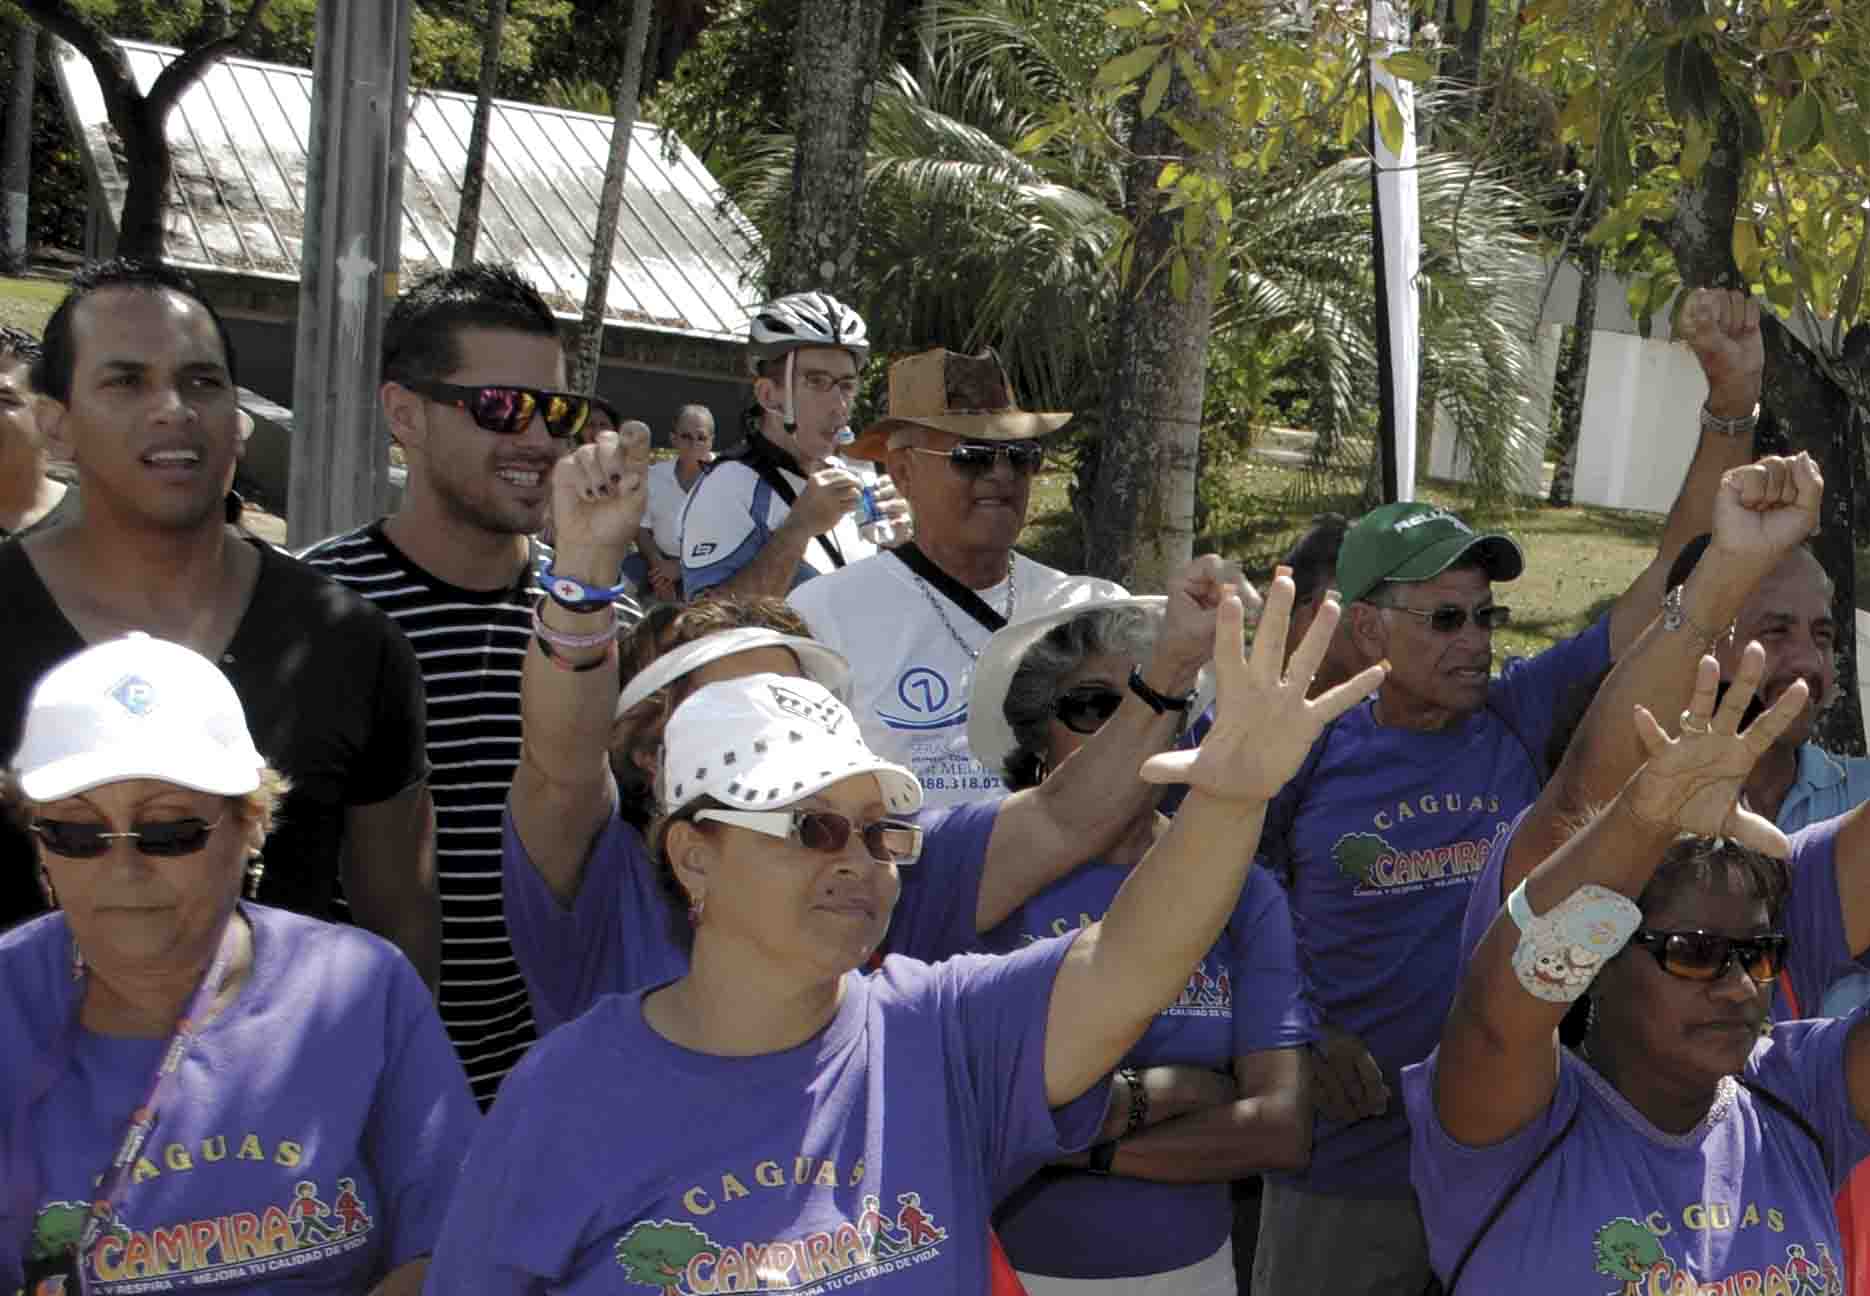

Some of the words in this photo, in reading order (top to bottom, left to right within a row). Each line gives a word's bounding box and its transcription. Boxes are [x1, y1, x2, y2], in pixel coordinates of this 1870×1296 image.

[1374, 794, 1500, 830] CAGUAS
[1376, 838, 1492, 887] CAMPIRA
[96, 1134, 304, 1187] AGUAS
[95, 1205, 299, 1282] CAMPIRA
[1646, 1201, 1785, 1236] CGUAS
[116, 1278, 174, 1296] RESPIRA
[192, 1267, 247, 1286] MEJORA
[249, 1263, 267, 1276] TU
[267, 1250, 323, 1271] CALIDAD
[325, 1245, 343, 1259] DE
[346, 1235, 369, 1253] VIDA
[687, 1222, 865, 1295] CAMPIRA
[826, 1277, 843, 1292] TU
[843, 1262, 895, 1286] CALIDAD
[895, 1255, 913, 1271] DE
[912, 1247, 940, 1265] VIDA
